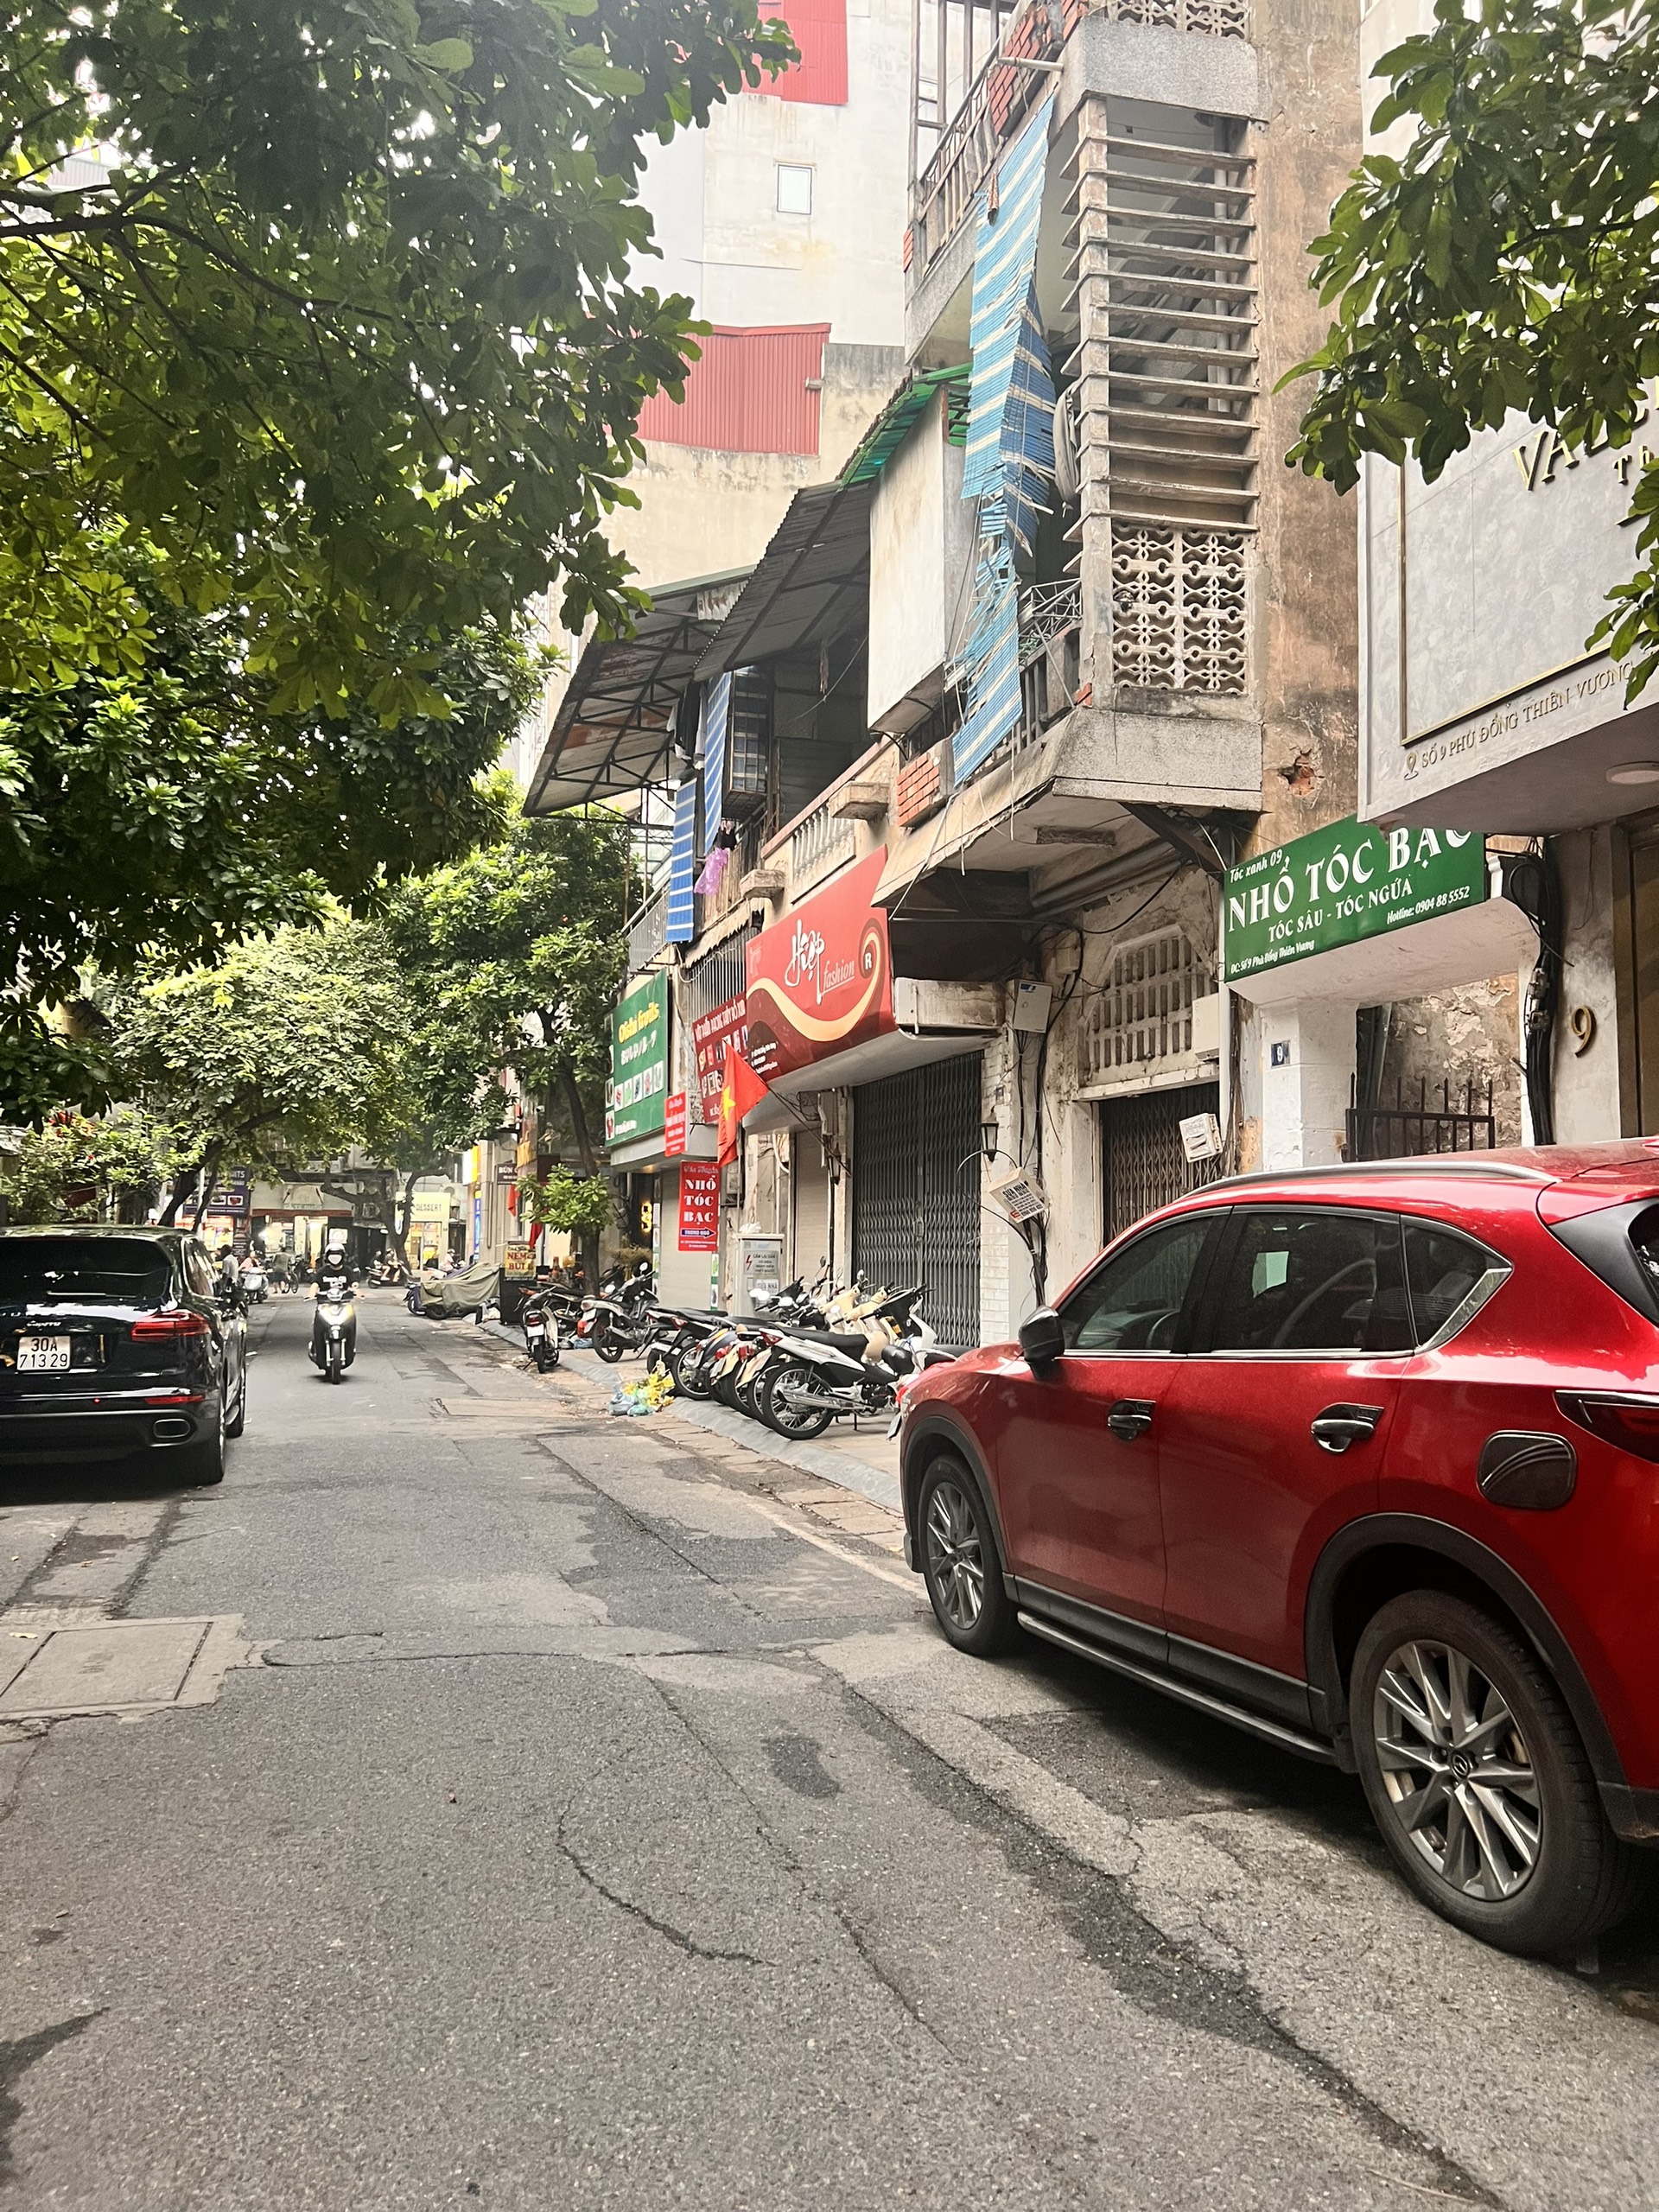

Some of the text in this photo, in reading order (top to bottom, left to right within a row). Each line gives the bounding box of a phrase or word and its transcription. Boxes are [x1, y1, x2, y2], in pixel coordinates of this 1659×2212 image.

[1421, 742, 1438, 768] SỐ
[1440, 745, 1446, 760] 9
[1522, 688, 1569, 723] THIÊN
[1230, 849, 1283, 883] Tóc xanh 09
[1228, 855, 1294, 932] NHỔ
[1306, 838, 1374, 903] TÓC
[1268, 918, 1294, 943] TÓC
[1296, 908, 1323, 934] SÂU
[1335, 894, 1364, 919] TÓC
[1368, 877, 1413, 909] NGỨA
[1387, 886, 1470, 925] Hotline: 0904 88 5552
[823, 959, 855, 993] fashion
[1570, 1005, 1597, 1058] 9
[683, 1193, 714, 1206] TÓC
[684, 1175, 716, 1191] NHỔ
[683, 1211, 714, 1225] BẠC
[31, 1338, 58, 1352] 30A
